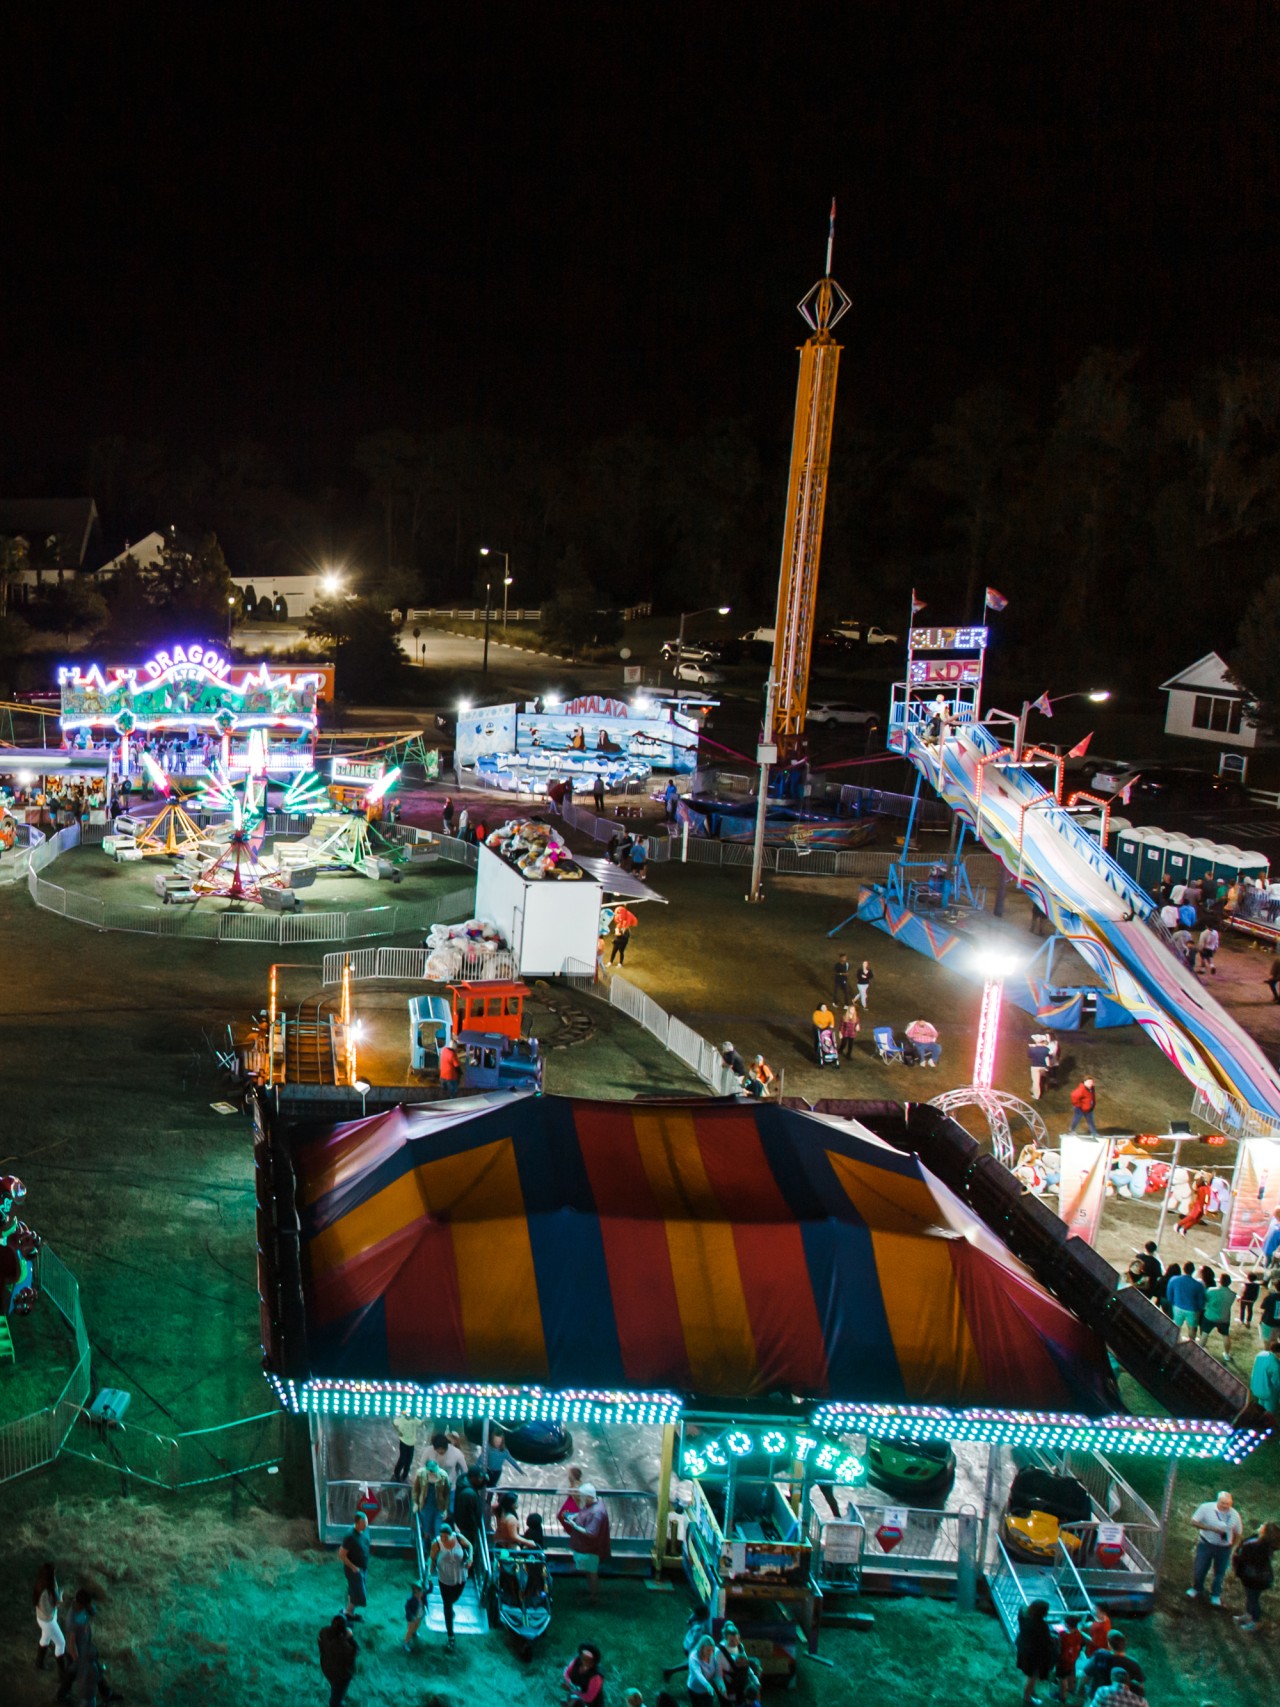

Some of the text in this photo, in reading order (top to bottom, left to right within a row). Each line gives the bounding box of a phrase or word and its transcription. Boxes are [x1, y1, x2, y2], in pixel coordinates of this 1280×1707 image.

[911, 629, 987, 648] SUPER
[145, 645, 232, 678] DRAGON
[910, 661, 980, 681] SLDE
[565, 696, 628, 718] HIMALAYA
[684, 1431, 865, 1483] SCOOTER
